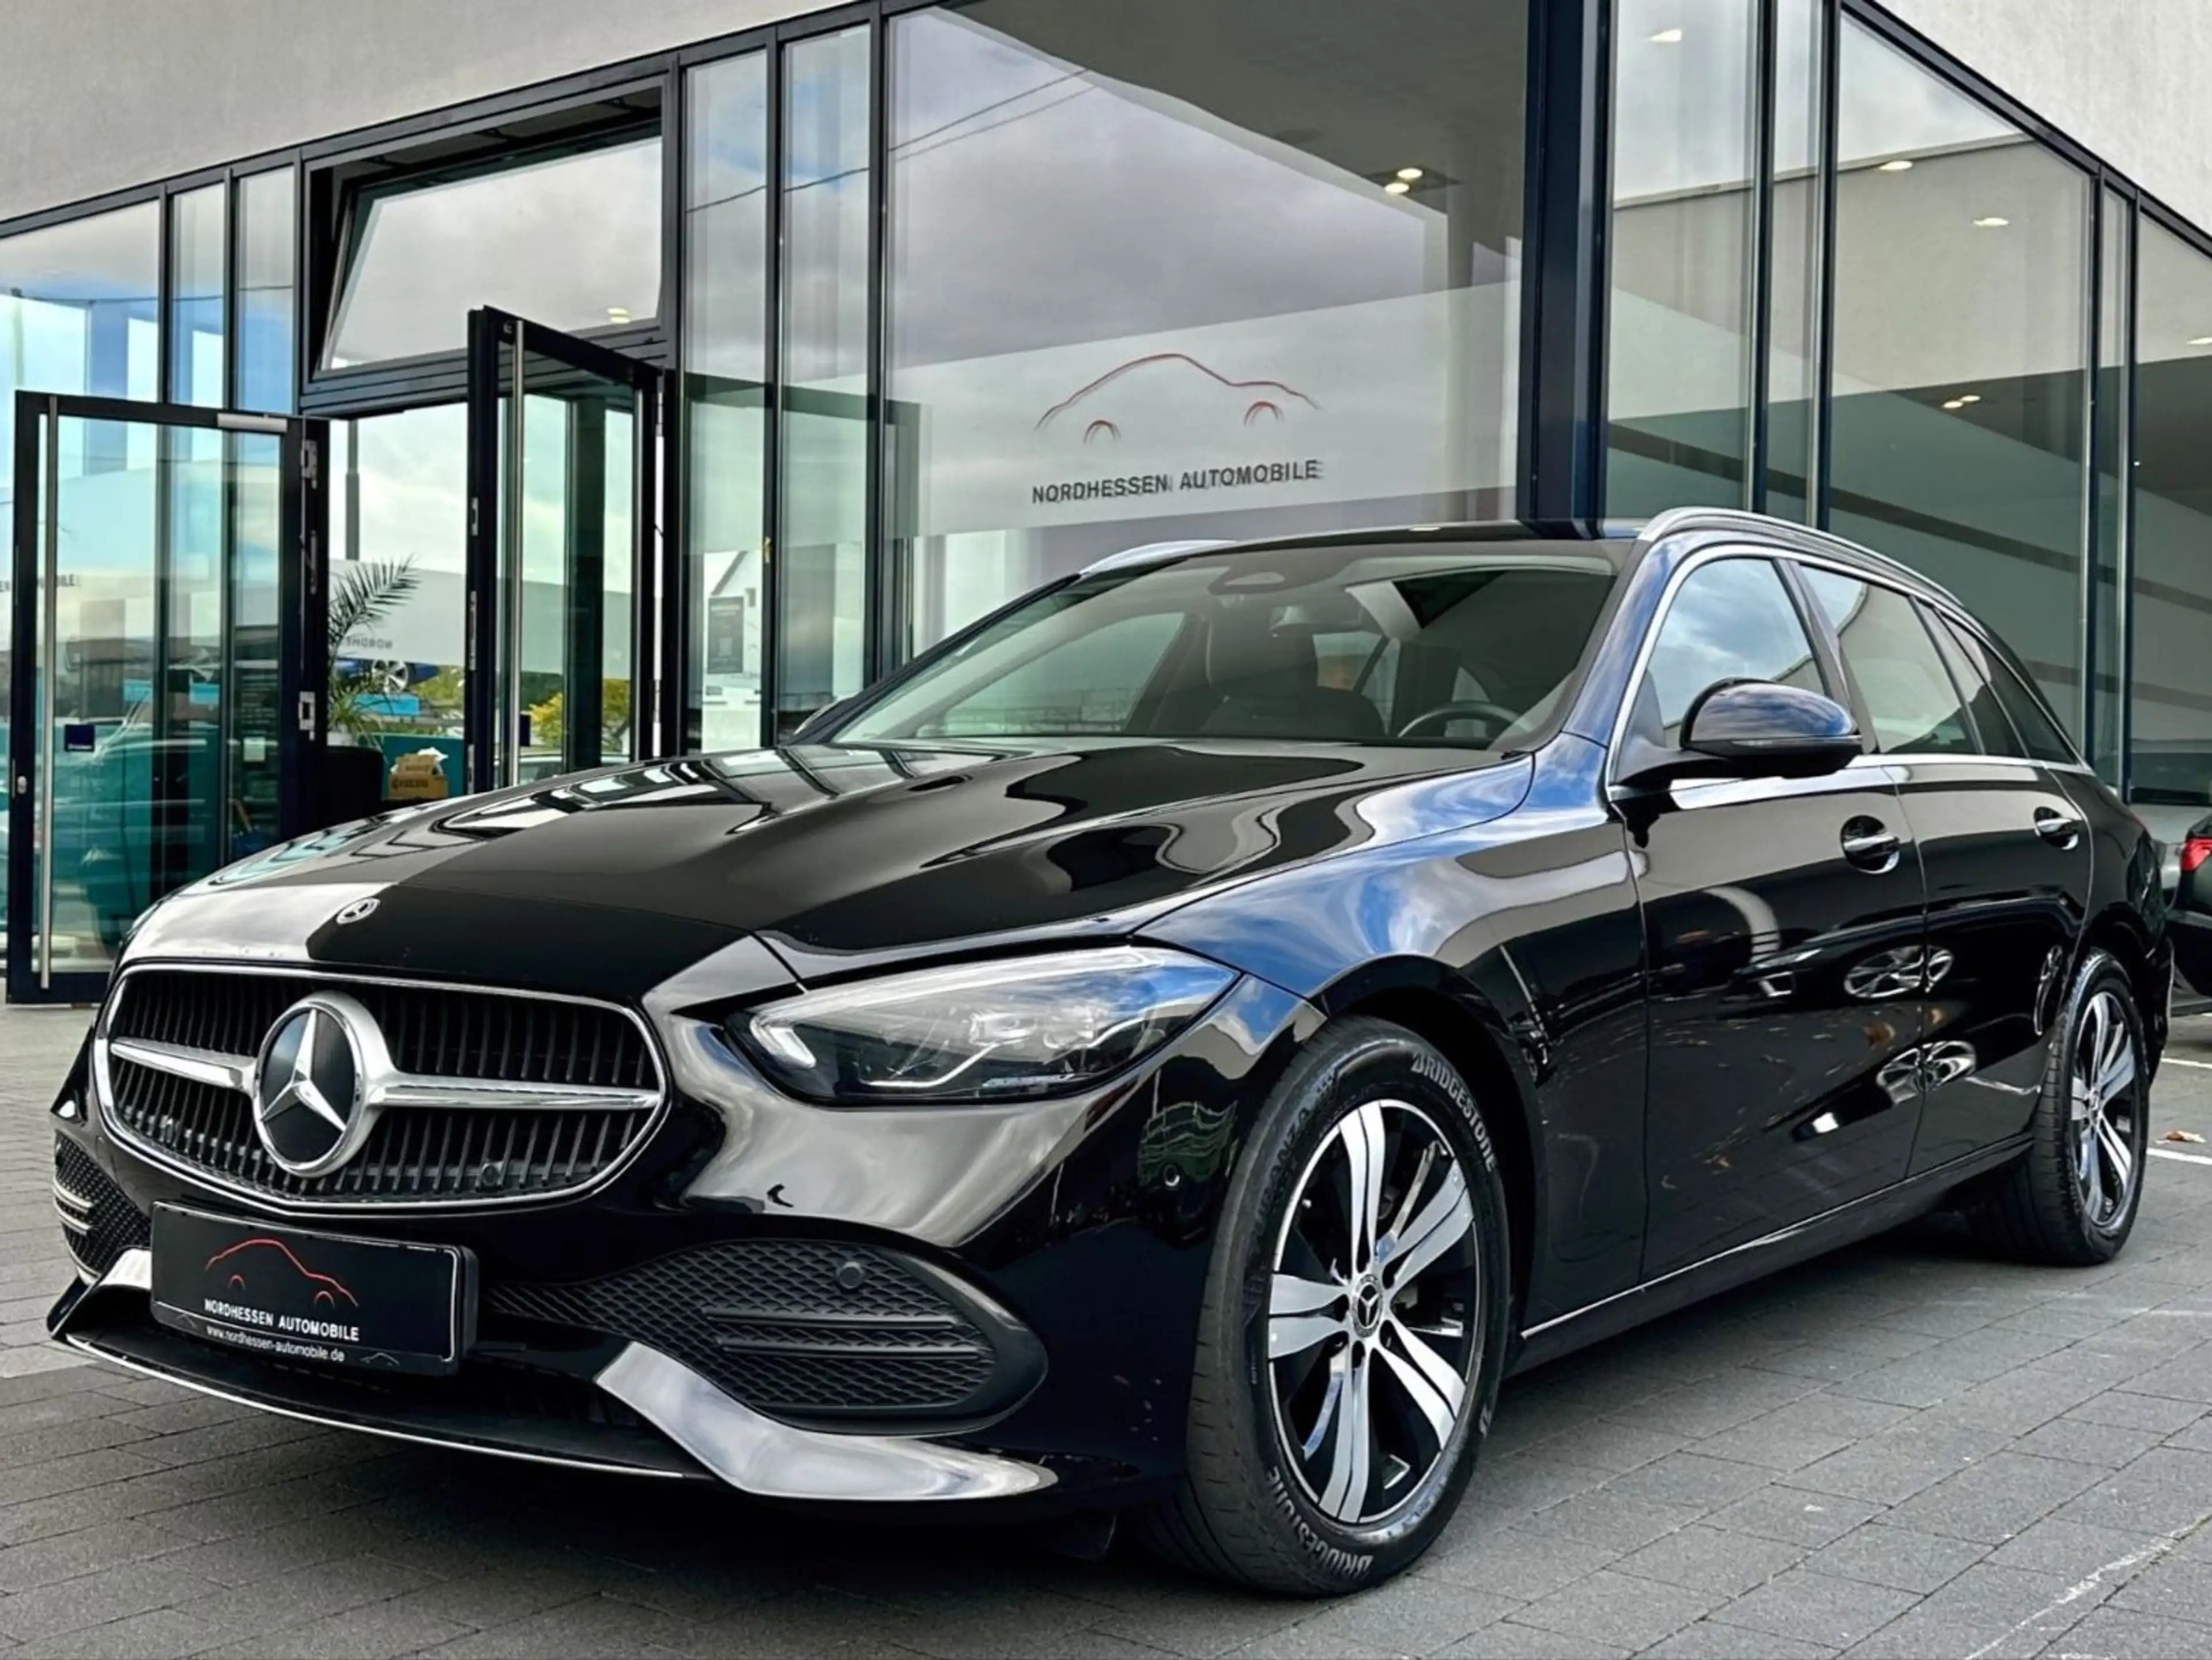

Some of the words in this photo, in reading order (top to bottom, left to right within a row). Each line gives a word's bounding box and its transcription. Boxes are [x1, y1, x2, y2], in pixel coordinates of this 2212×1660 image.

[1032, 474, 1170, 503] NORDHESSEN
[1179, 459, 1320, 491] AUTOMOBILE
[1410, 1050, 1497, 1173] BRIDGESTONE
[204, 1299, 274, 1326] NORDHESSEN
[278, 1315, 360, 1341] AUTOMOBILE
[206, 1325, 345, 1361] www.nordhessen-automobile.de
